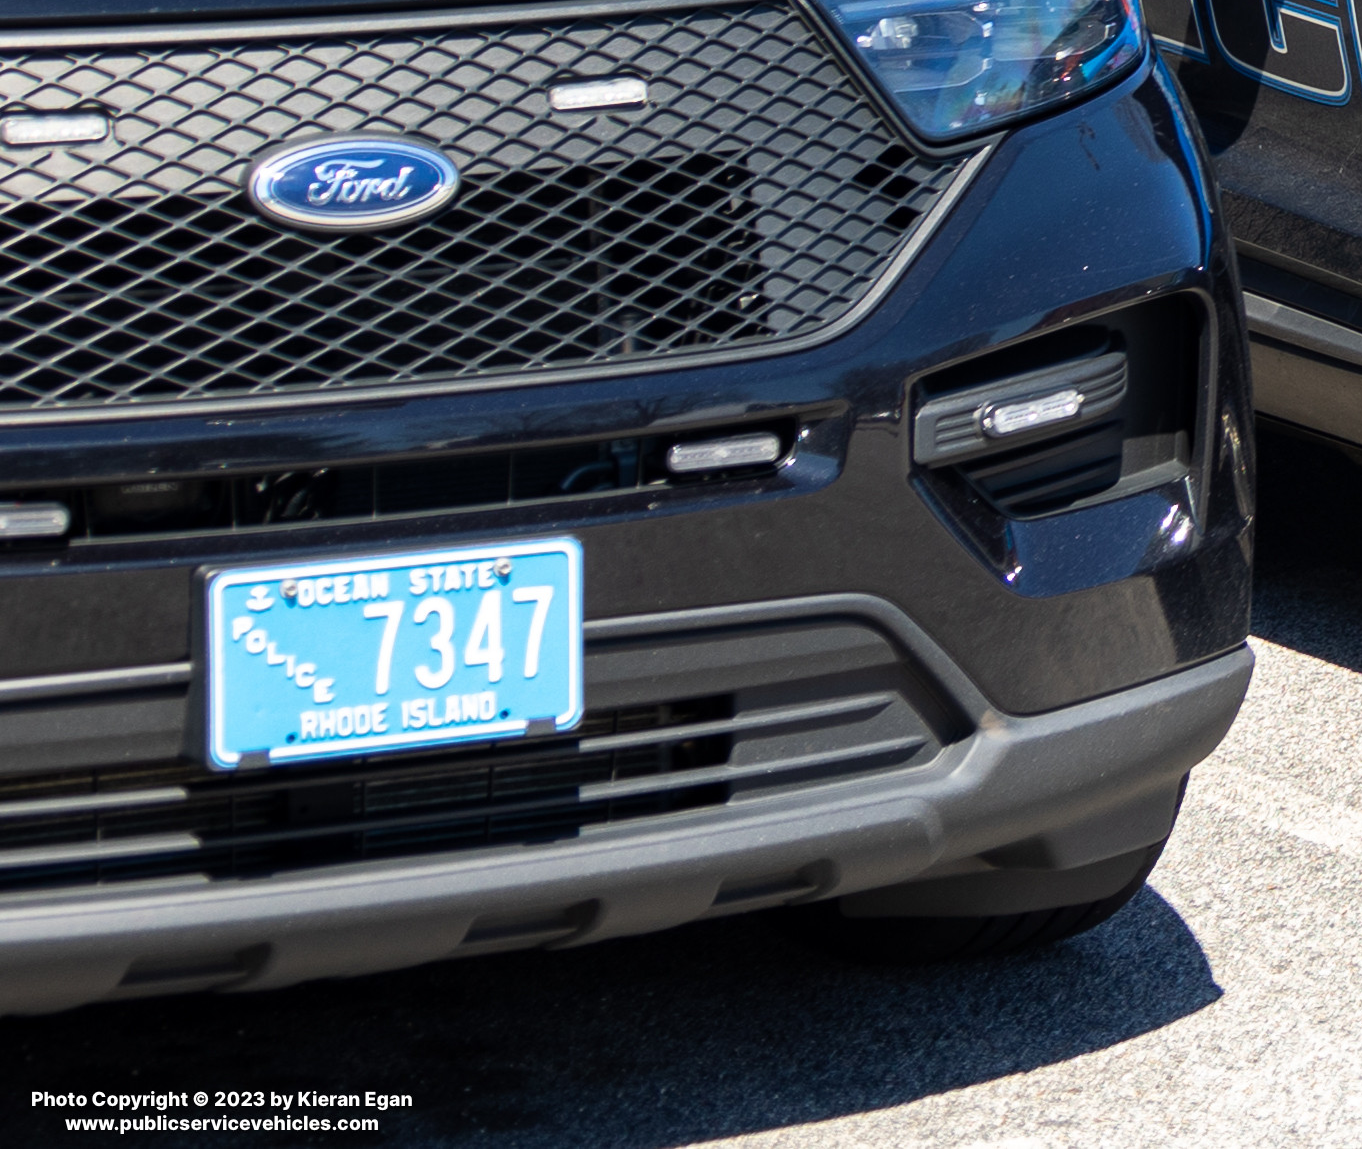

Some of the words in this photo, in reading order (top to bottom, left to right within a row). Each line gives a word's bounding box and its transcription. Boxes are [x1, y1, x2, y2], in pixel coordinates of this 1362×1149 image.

[307, 157, 410, 206] Ford
[297, 573, 389, 607] OCEAN
[409, 562, 495, 595] STATE
[232, 616, 334, 704] POLICE
[363, 585, 554, 696] 7347
[300, 702, 389, 740] RHODE
[402, 691, 496, 728] ISLAND
